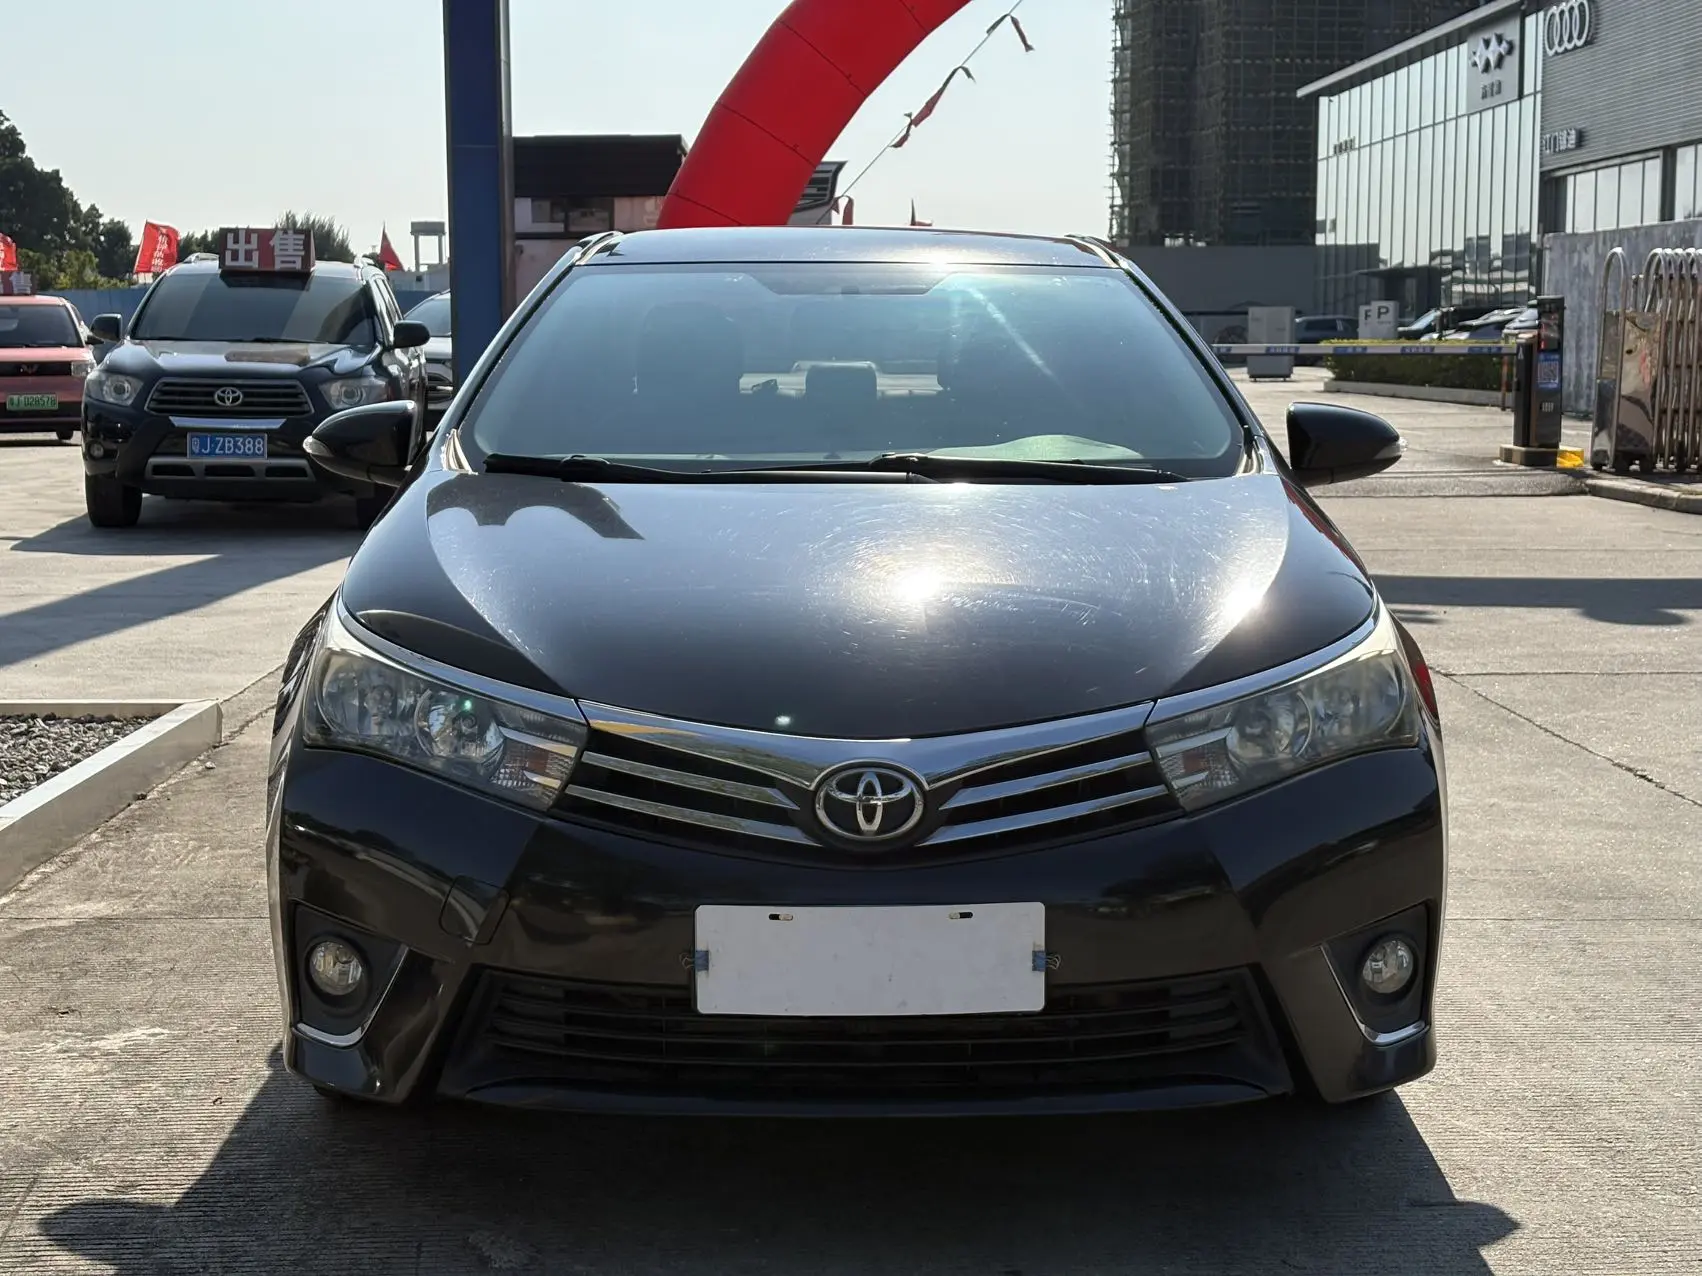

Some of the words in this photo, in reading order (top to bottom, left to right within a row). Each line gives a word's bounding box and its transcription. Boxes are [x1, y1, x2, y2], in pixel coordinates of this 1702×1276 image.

[224, 229, 306, 270] 出售
[0, 271, 32, 296] 售
[1376, 305, 1390, 319] P
